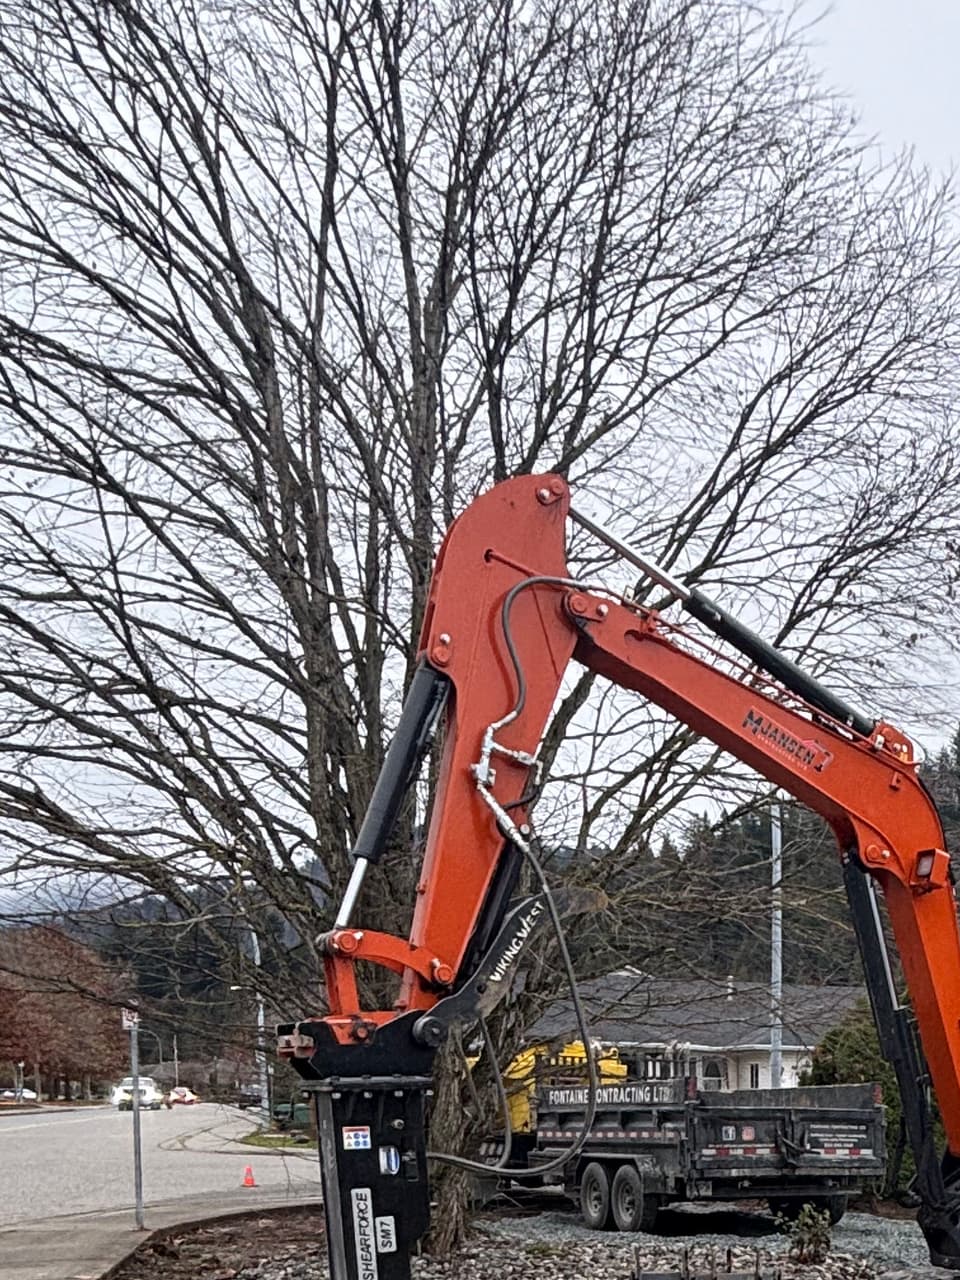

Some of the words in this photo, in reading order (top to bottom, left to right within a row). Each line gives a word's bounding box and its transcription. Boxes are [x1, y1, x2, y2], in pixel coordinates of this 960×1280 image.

[489, 938, 524, 982] VIKING
[549, 1089, 589, 1105] FONTAINE
[593, 1085, 651, 1103] ONTRACTING
[355, 1192, 375, 1280] SHEARFORCE
[379, 1220, 393, 1249] SM7
